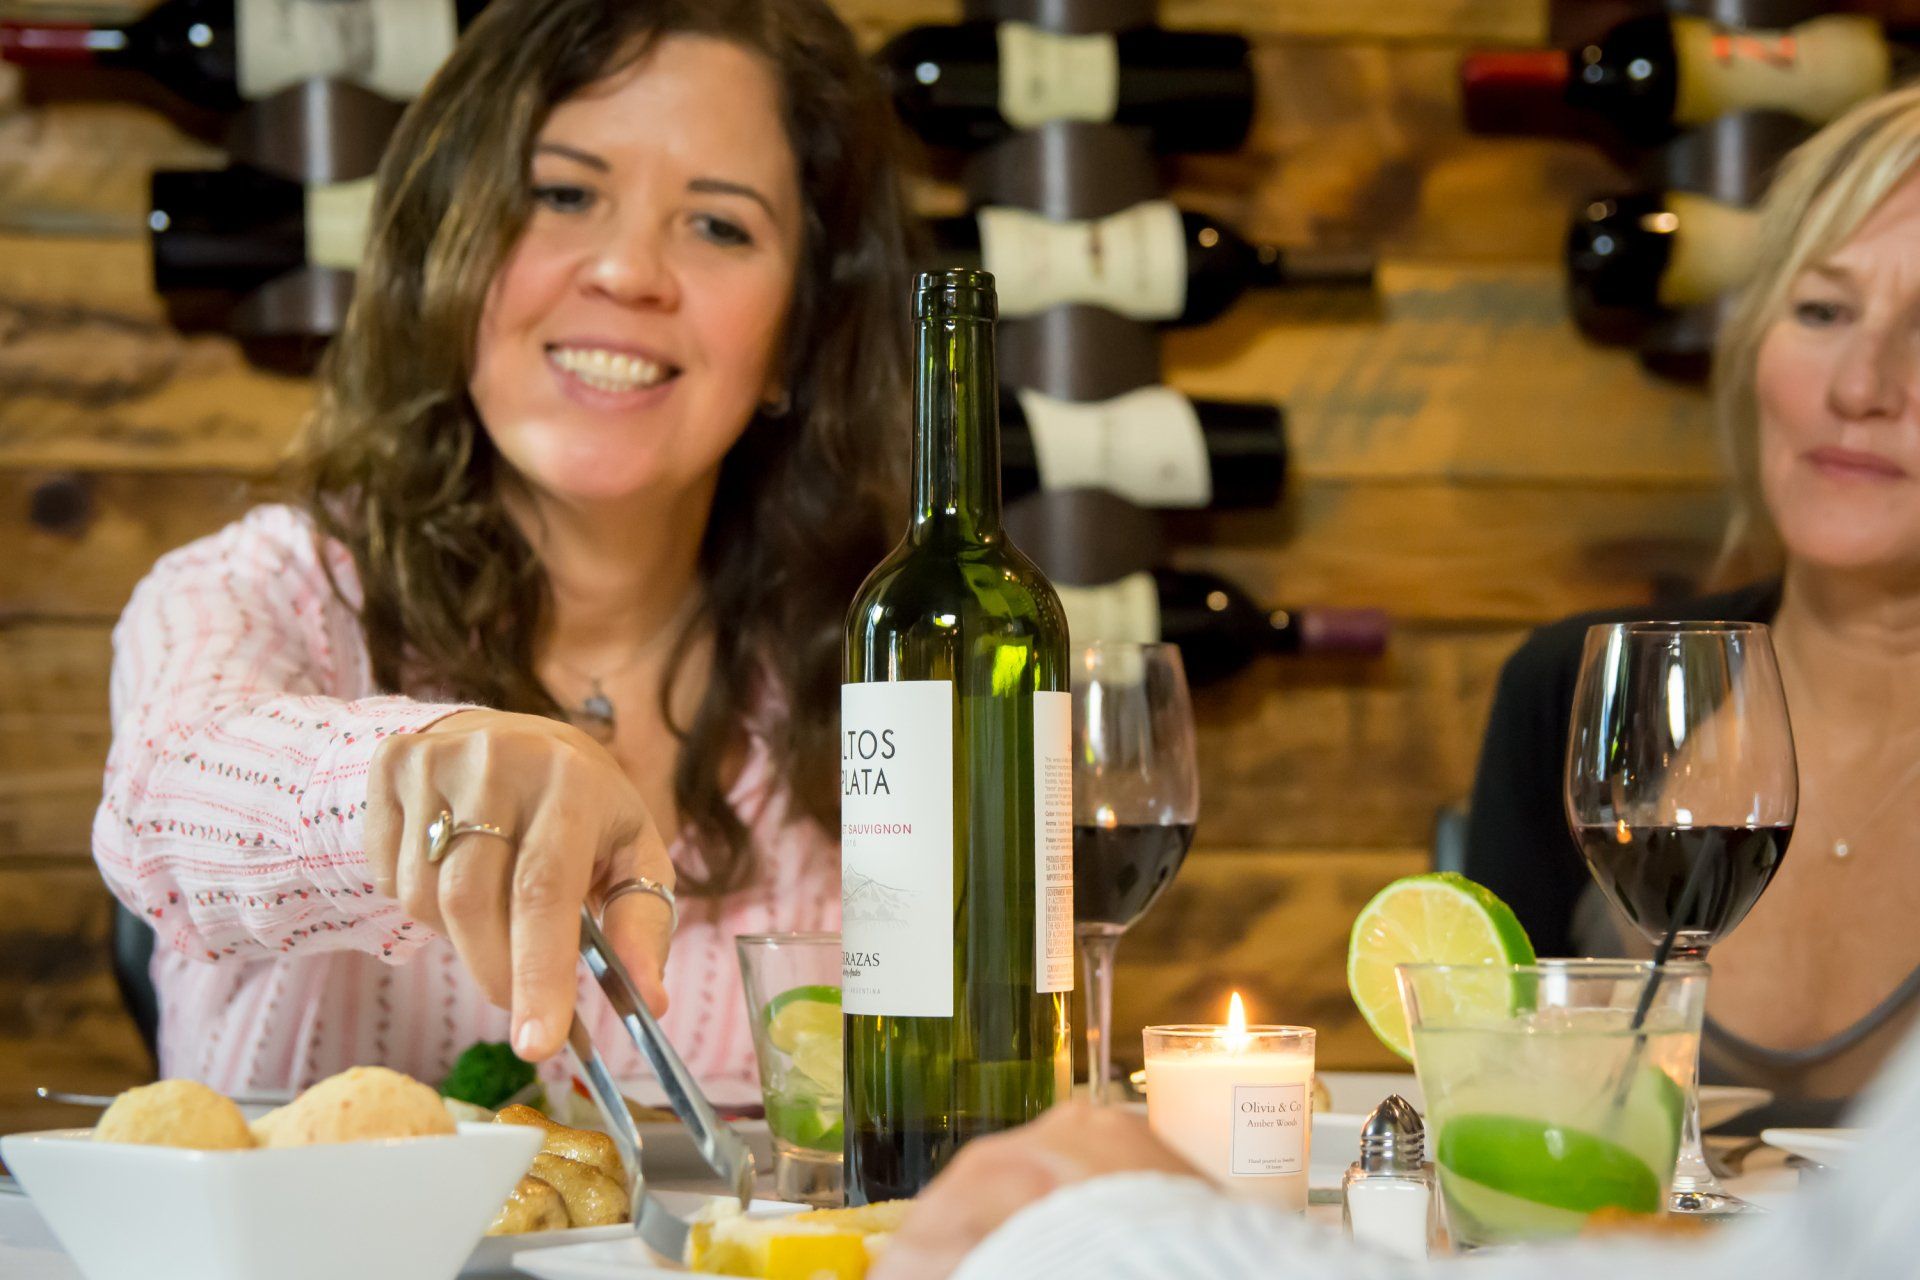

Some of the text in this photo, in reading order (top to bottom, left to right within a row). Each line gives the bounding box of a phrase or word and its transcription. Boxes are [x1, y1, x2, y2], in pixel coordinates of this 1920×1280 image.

[848, 823, 912, 835] SAUVIGNON
[1241, 1101, 1276, 1113] Olivia
[1278, 1102, 1287, 1113] &
[1247, 1117, 1298, 1128] Amber Woods
